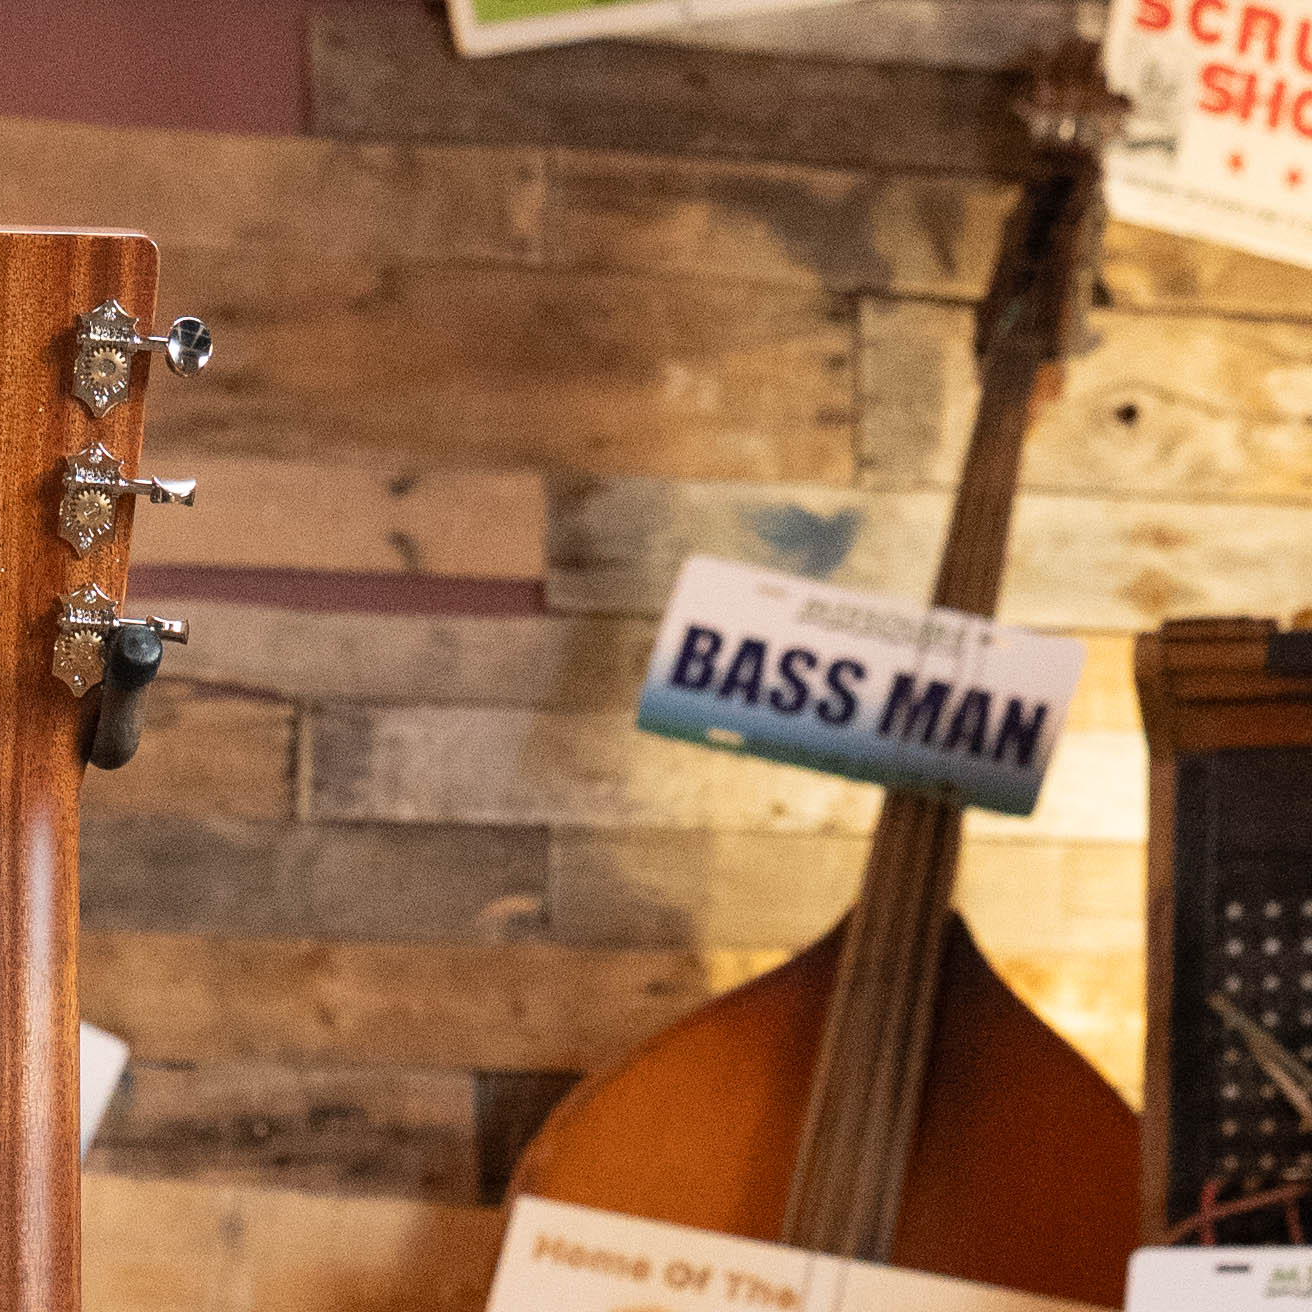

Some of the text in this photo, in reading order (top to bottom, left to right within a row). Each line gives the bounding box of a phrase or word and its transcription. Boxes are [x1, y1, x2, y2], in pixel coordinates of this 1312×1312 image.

[669, 622, 867, 727] BASS
[877, 670, 1049, 769] MAN
[531, 1233, 801, 1310] Home Of The
